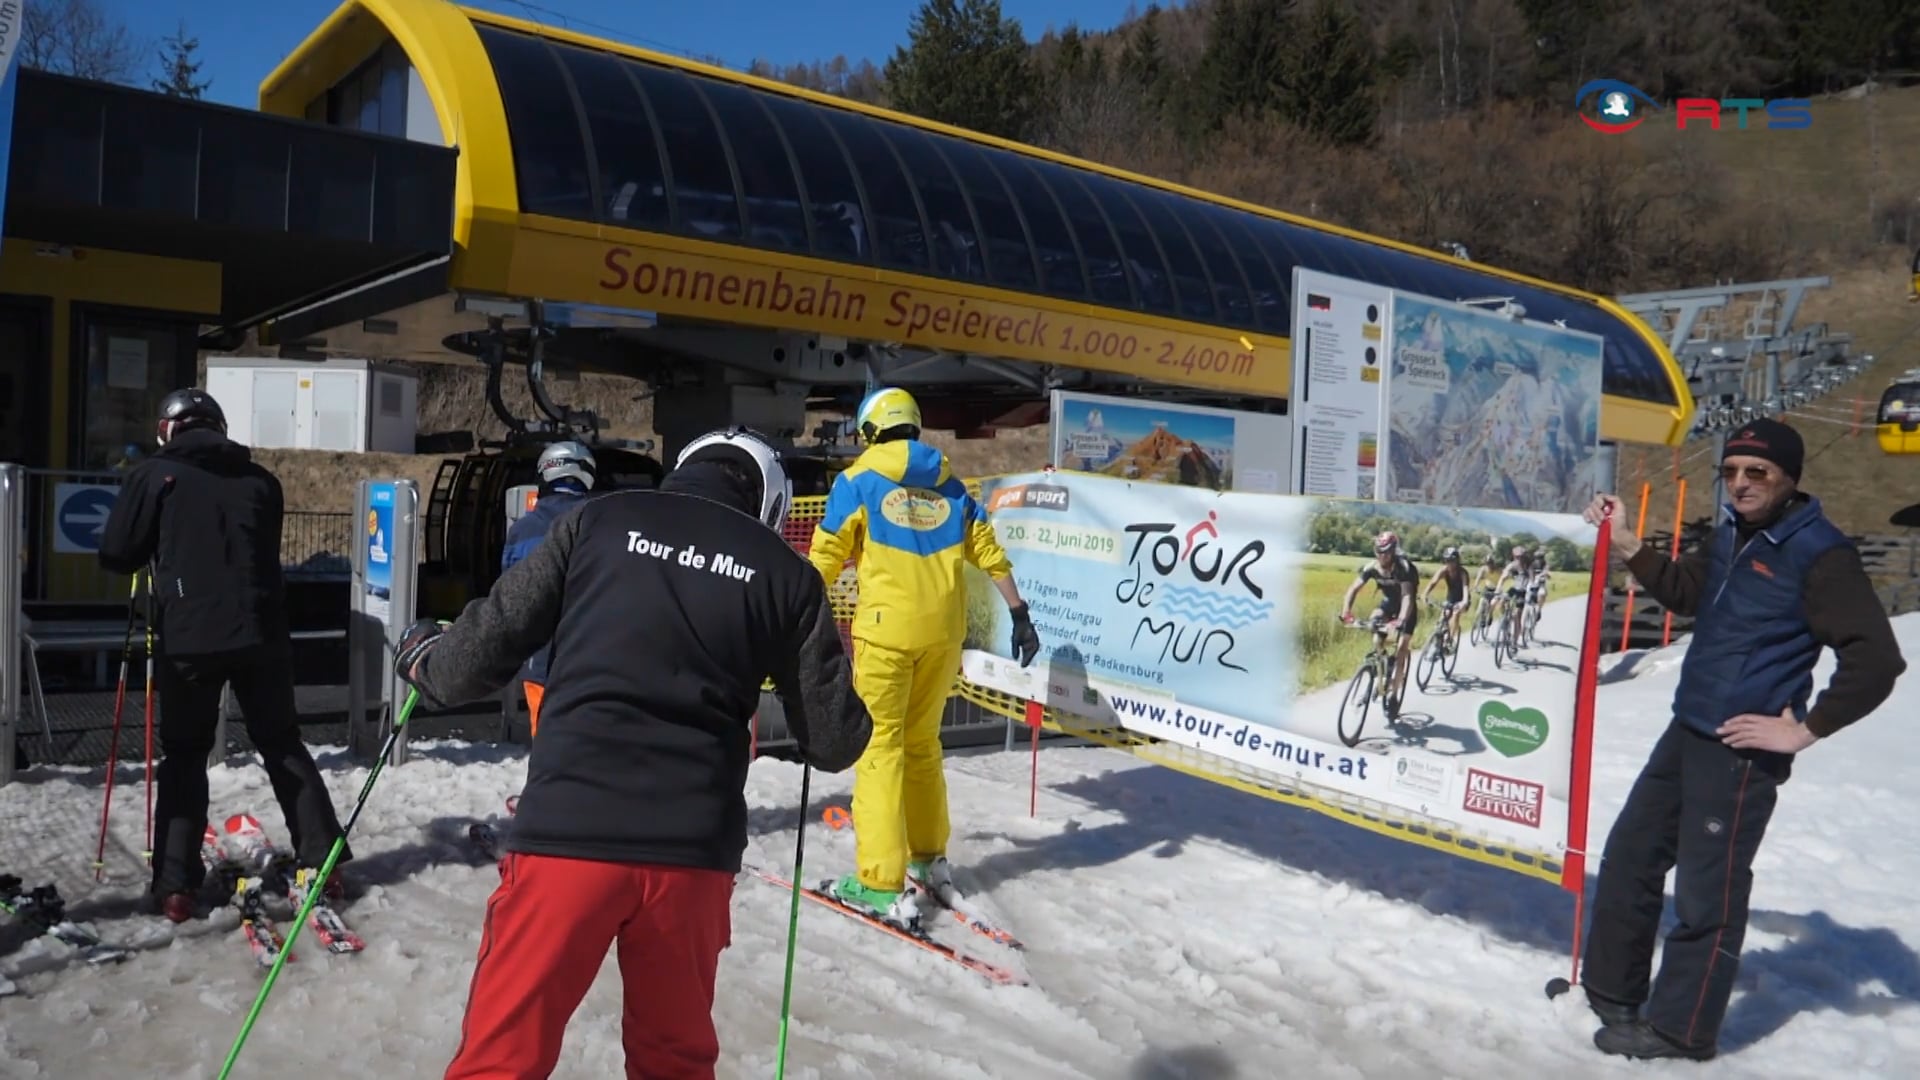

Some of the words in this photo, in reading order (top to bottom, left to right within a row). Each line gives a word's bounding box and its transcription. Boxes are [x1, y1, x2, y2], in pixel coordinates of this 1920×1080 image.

[599, 247, 867, 322] Sonnenbahn
[884, 290, 1049, 347] Speiereck
[1059, 326, 1137, 360] 1.000
[627, 530, 674, 561] Tour
[677, 545, 706, 569] de
[710, 553, 756, 583] Mur
[1006, 526, 1029, 540] 20.
[1038, 527, 1053, 545] 22.
[1055, 530, 1081, 549] Juni
[1083, 534, 1114, 553] 2019
[1124, 522, 1265, 600] TOUR
[1034, 580, 1058, 598] Tagen
[1061, 590, 1078, 600] von
[1116, 560, 1155, 608] de
[1034, 619, 1079, 641] Fohnsdorf
[1080, 634, 1101, 646] und
[1131, 616, 1248, 673] MUR
[1093, 653, 1164, 684] Radkersburg
[1110, 695, 1368, 780] www.tour-de-mur.at
[1465, 791, 1538, 823] ZEITUNG
[1468, 772, 1539, 806] KLEINE
